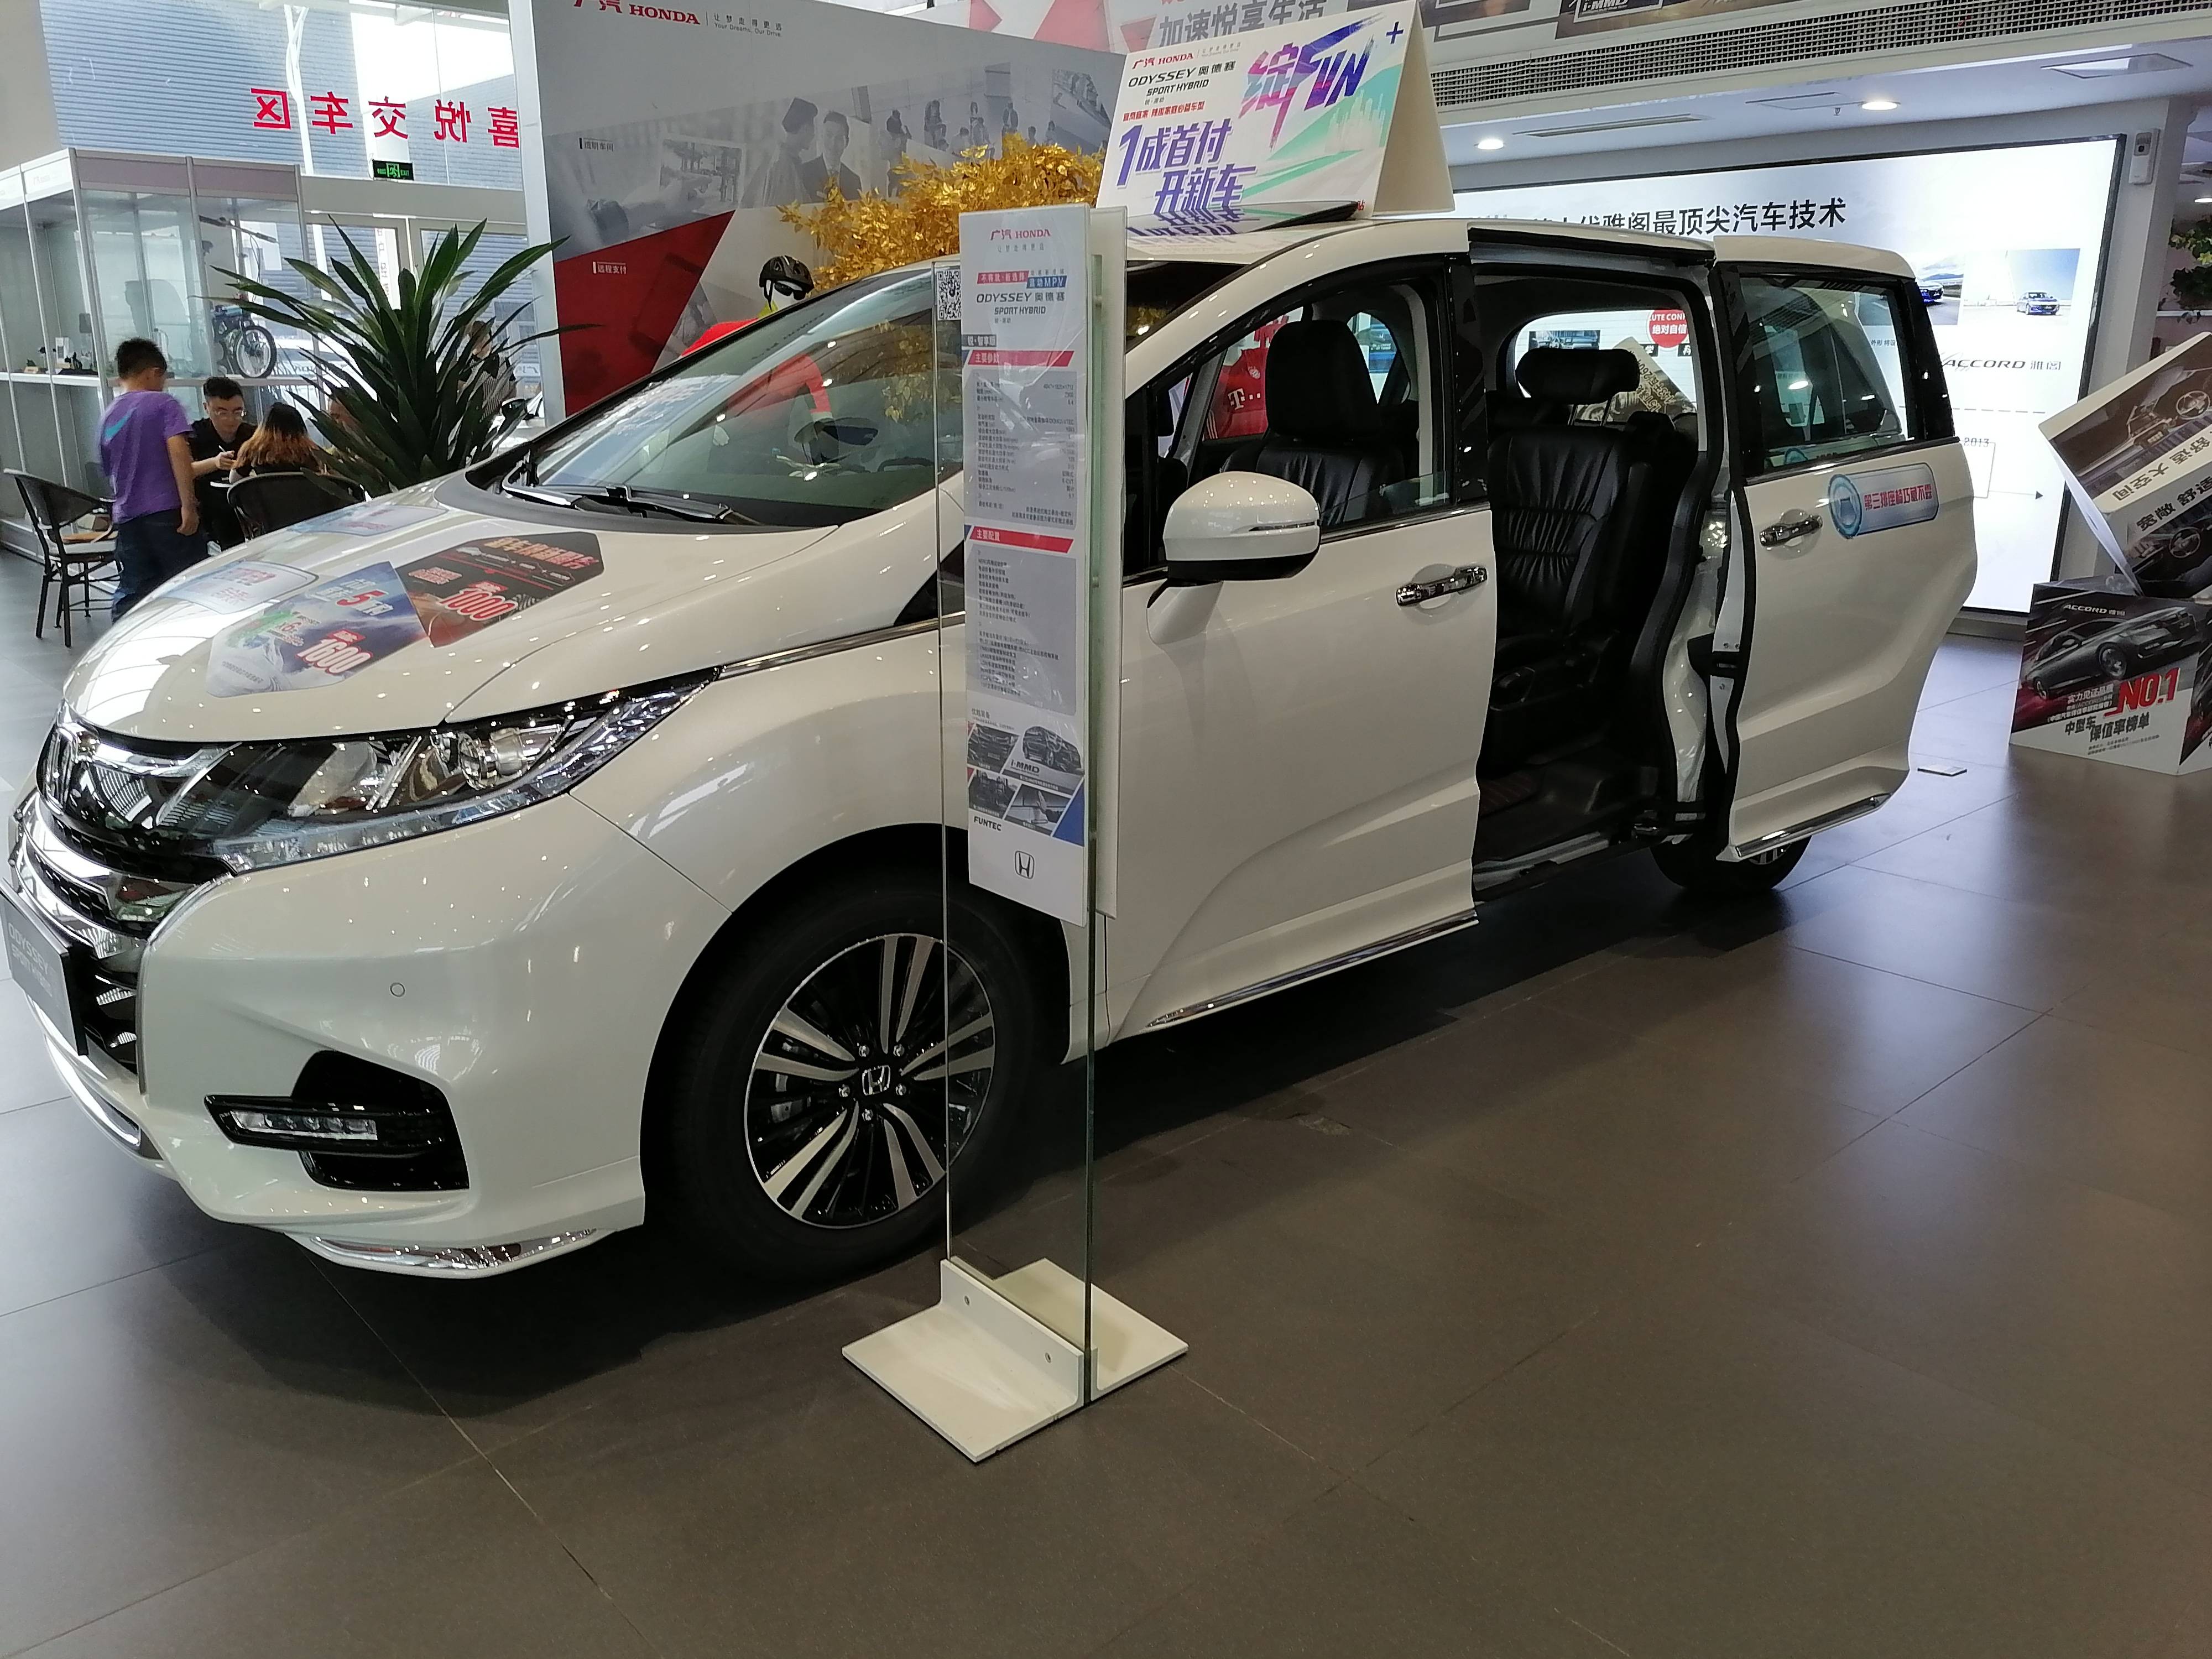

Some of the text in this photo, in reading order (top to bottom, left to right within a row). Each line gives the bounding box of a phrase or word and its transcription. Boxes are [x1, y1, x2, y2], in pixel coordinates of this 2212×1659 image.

[629, 4, 701, 24] HONDA
[1132, 56, 1155, 69] 广汽
[1158, 53, 1194, 65] HONDA
[1129, 61, 1236, 87] ODYSSEY 奥德赛
[1146, 79, 1209, 97] SPORT HYBRID
[1116, 117, 1232, 186] 1成首付
[1154, 163, 1256, 215] 开新车
[990, 229, 1051, 241] 广汽 HONDA
[976, 292, 1065, 303] ODYSSEY 奥德赛
[1019, 306, 1046, 315] HYBRID
[1652, 324, 1687, 335] 绝对自信
[1943, 359, 2026, 369] ACCORD
[1964, 437, 1990, 447] 2013
[2136, 503, 2176, 531] 宽敞
[976, 529, 1000, 542] 主要配置
[437, 588, 518, 622] 1000
[2063, 604, 2107, 614] ACCORD
[296, 637, 373, 674] 1600
[2106, 667, 2181, 716] NO.1
[2065, 716, 2097, 735] 中型车
[2090, 712, 2150, 742] 保值率榜单
[973, 816, 1002, 832] FUNTEC
